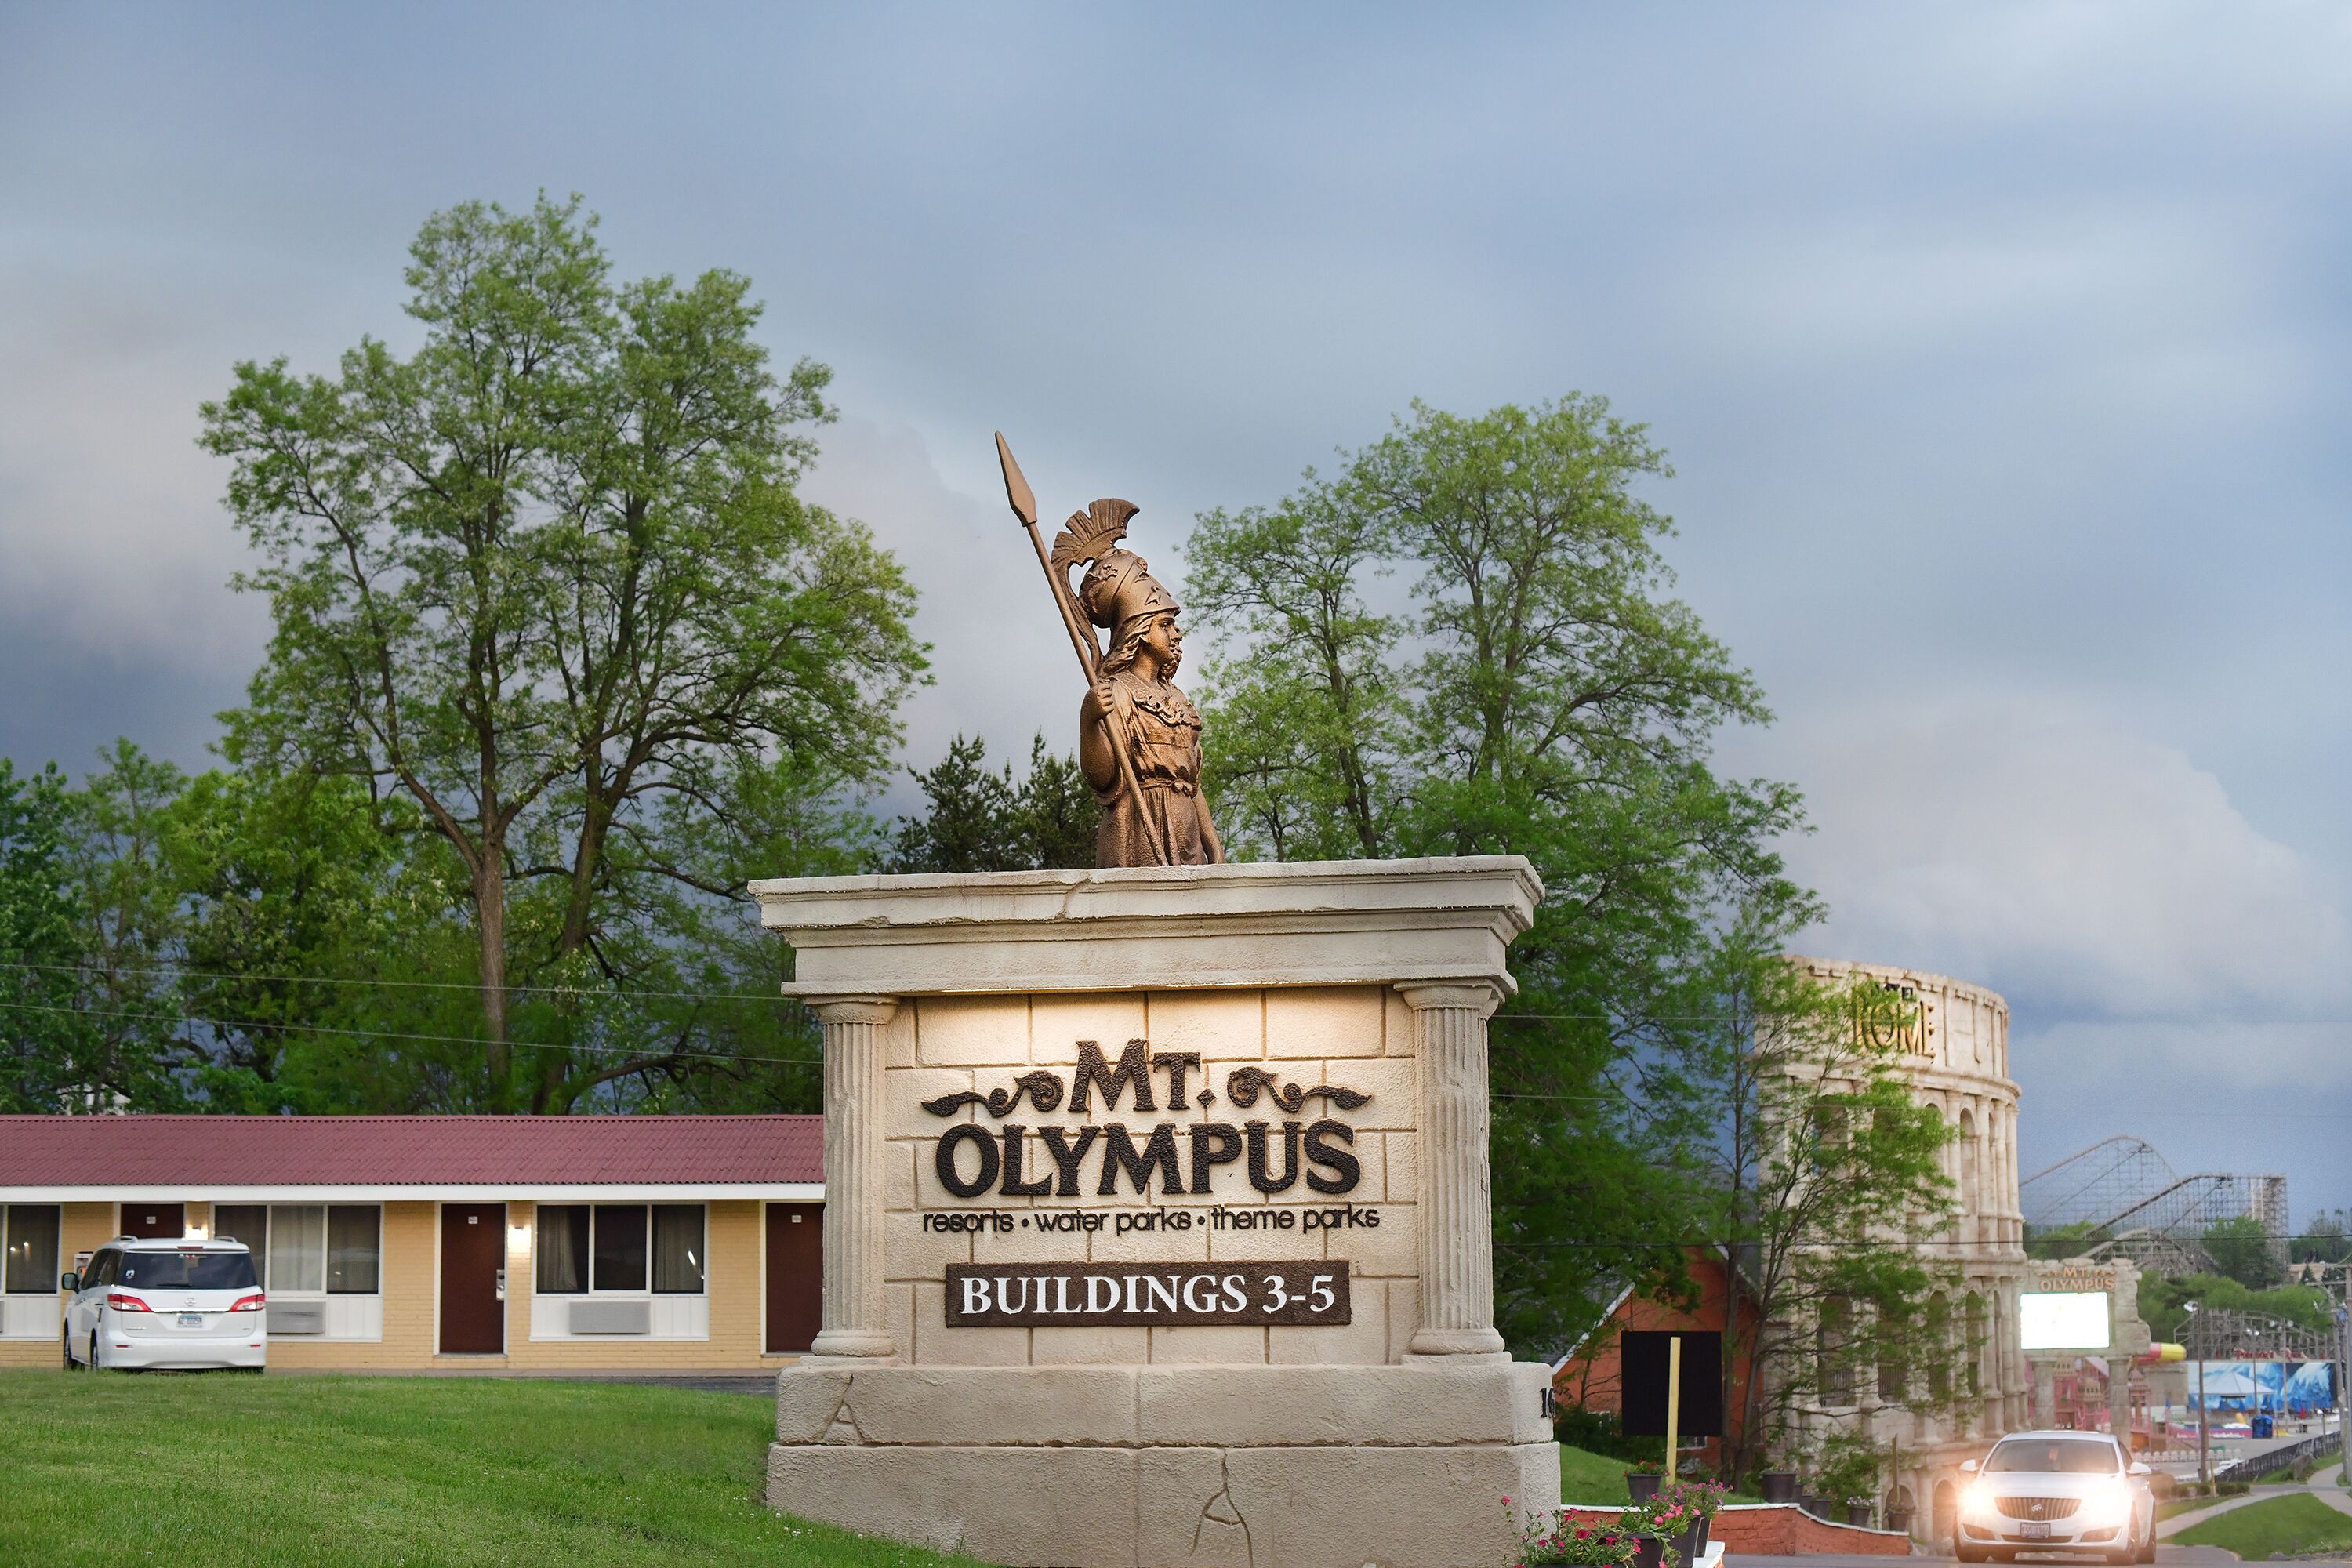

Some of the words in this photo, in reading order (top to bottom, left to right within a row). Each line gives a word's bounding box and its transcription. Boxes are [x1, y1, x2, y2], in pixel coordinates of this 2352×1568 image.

[1067, 1039, 1217, 1112] MT.
[935, 1118, 1361, 1198] OLYMPUS
[924, 1208, 1014, 1232] resorts
[1034, 1208, 1106, 1232] water
[1116, 1207, 1191, 1235] parks
[1211, 1205, 1296, 1230] theme
[1302, 1203, 1381, 1235] parks
[960, 1273, 1248, 1315] BUILDINGS
[1261, 1274, 1336, 1313] 3-5
[2040, 1279, 2114, 1292] OLYMPUS
